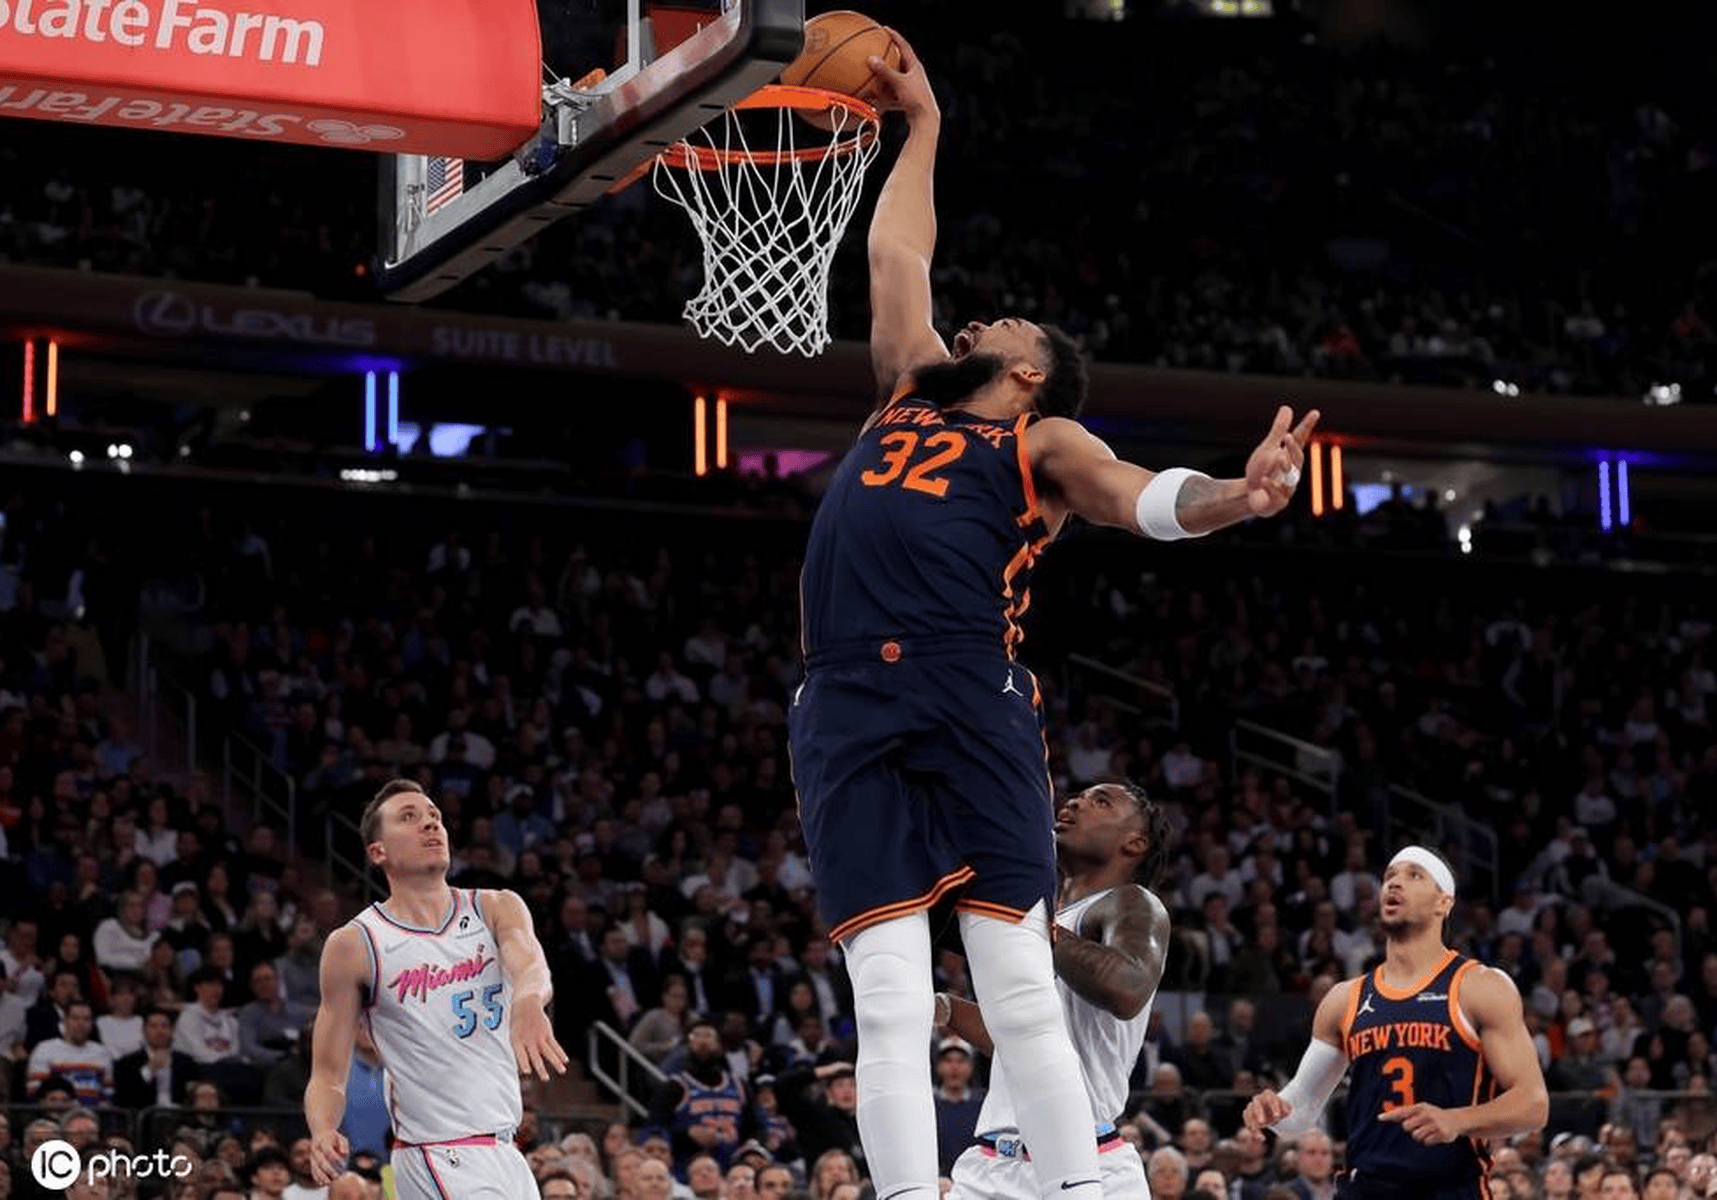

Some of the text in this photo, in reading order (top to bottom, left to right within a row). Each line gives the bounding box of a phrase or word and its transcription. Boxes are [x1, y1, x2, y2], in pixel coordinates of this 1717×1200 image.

[155, 0, 325, 66] Farm
[202, 306, 375, 346] LEXUS
[431, 327, 620, 368] SUITE LEVEL
[861, 430, 967, 497] 32
[387, 943, 495, 1005] Miami
[451, 983, 503, 1039] 55
[1349, 1021, 1452, 1061] NEW YORK
[1382, 1056, 1415, 1112] 3
